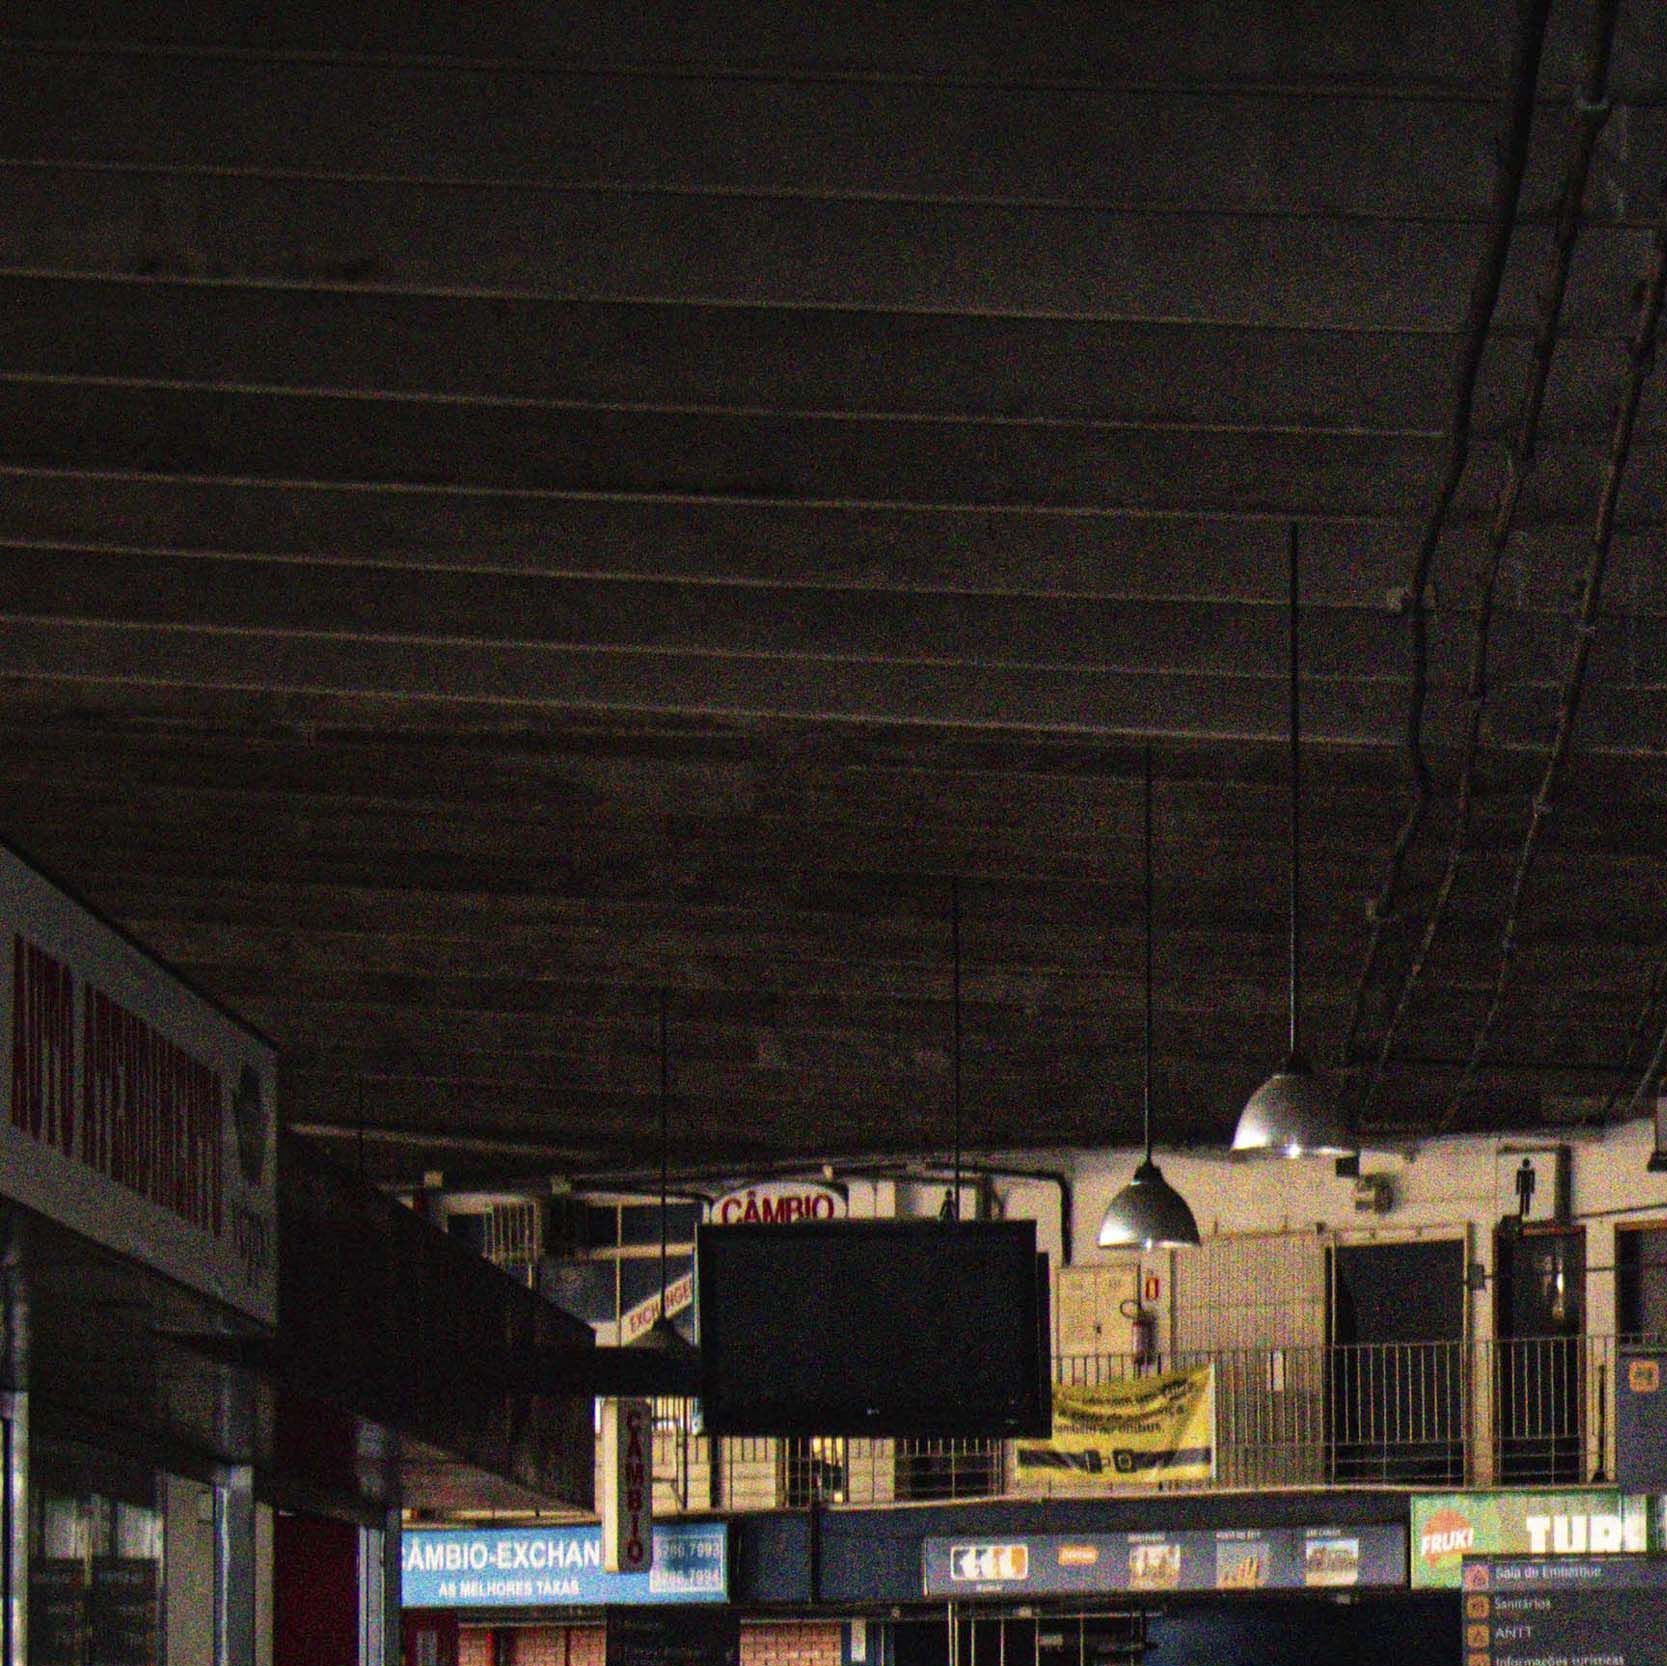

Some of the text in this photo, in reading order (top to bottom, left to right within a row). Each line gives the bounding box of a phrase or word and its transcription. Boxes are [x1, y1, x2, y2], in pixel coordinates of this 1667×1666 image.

[721, 1190, 834, 1224] CÂMBIO
[629, 1279, 691, 1334] EXCHNGE
[401, 1537, 601, 1572] ÂMBIO-EXCHAN
[1421, 1528, 1474, 1556] FRUKI
[460, 1579, 533, 1598] MELHORES
[536, 1577, 581, 1596] TAXAS
